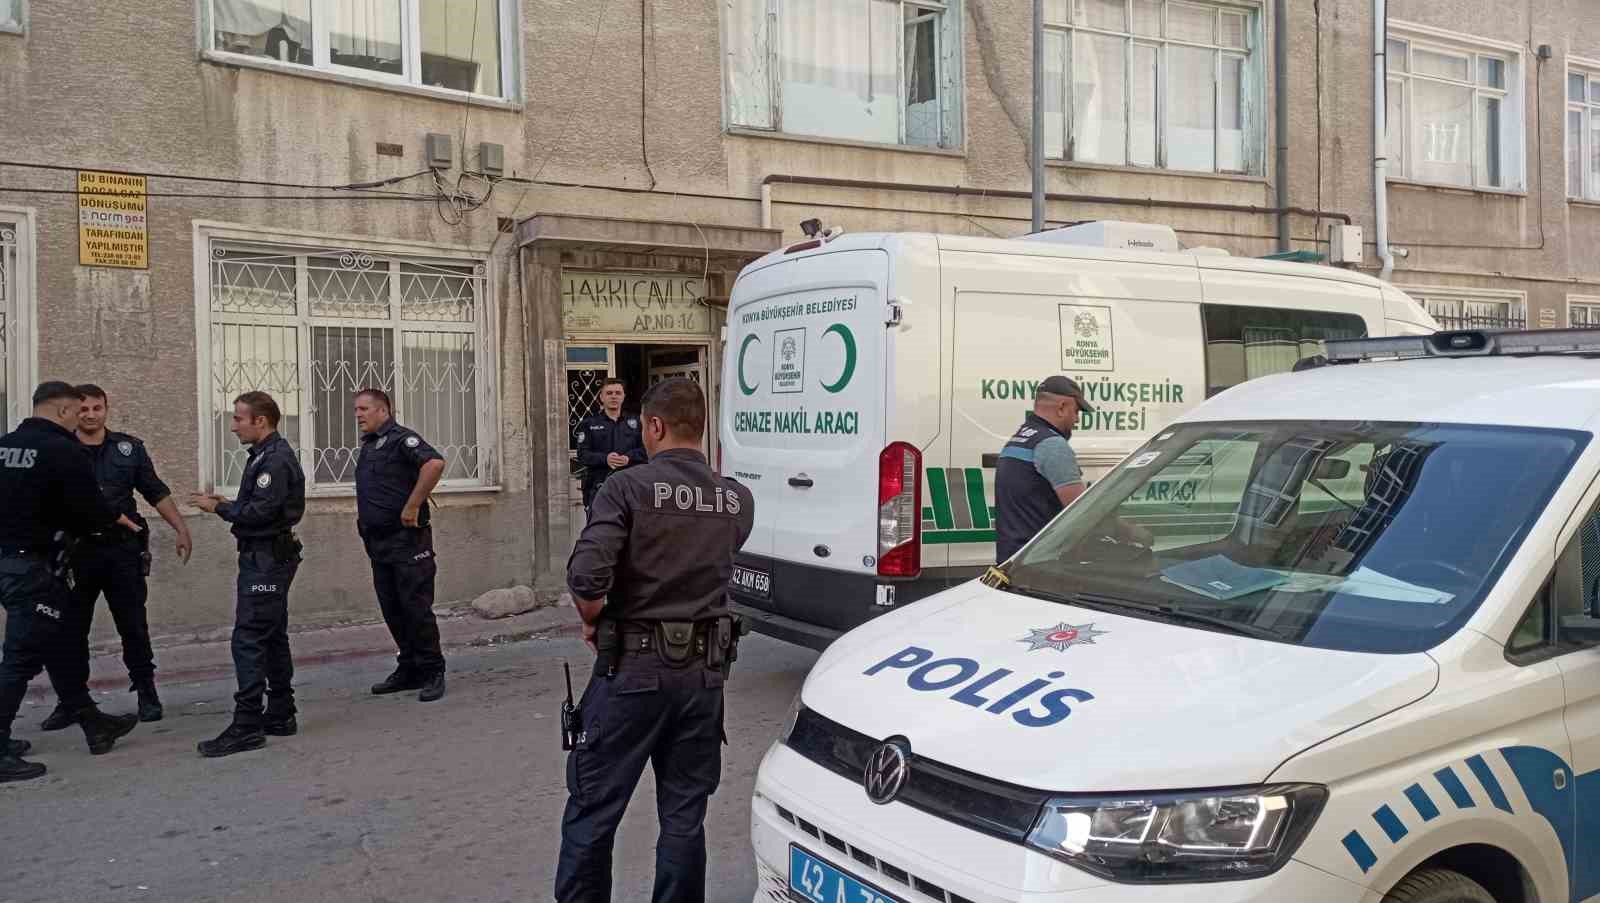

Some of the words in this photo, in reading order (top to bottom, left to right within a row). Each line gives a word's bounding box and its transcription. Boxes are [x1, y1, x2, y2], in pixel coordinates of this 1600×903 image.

[80, 173, 95, 183] BU
[86, 228, 144, 241] TARAFINDAN
[742, 311, 760, 324] KONYA
[761, 301, 803, 320] BÜYÜKŞEHİR
[806, 295, 857, 315] BELEDİYESİ
[981, 378, 1040, 401] KONY
[735, 411, 772, 433] CENAZE
[774, 406, 812, 434] NAKİL
[814, 411, 859, 434] ARACI
[755, 574, 770, 593] 658
[862, 645, 1095, 728] POLİS
[801, 859, 824, 902] 42
